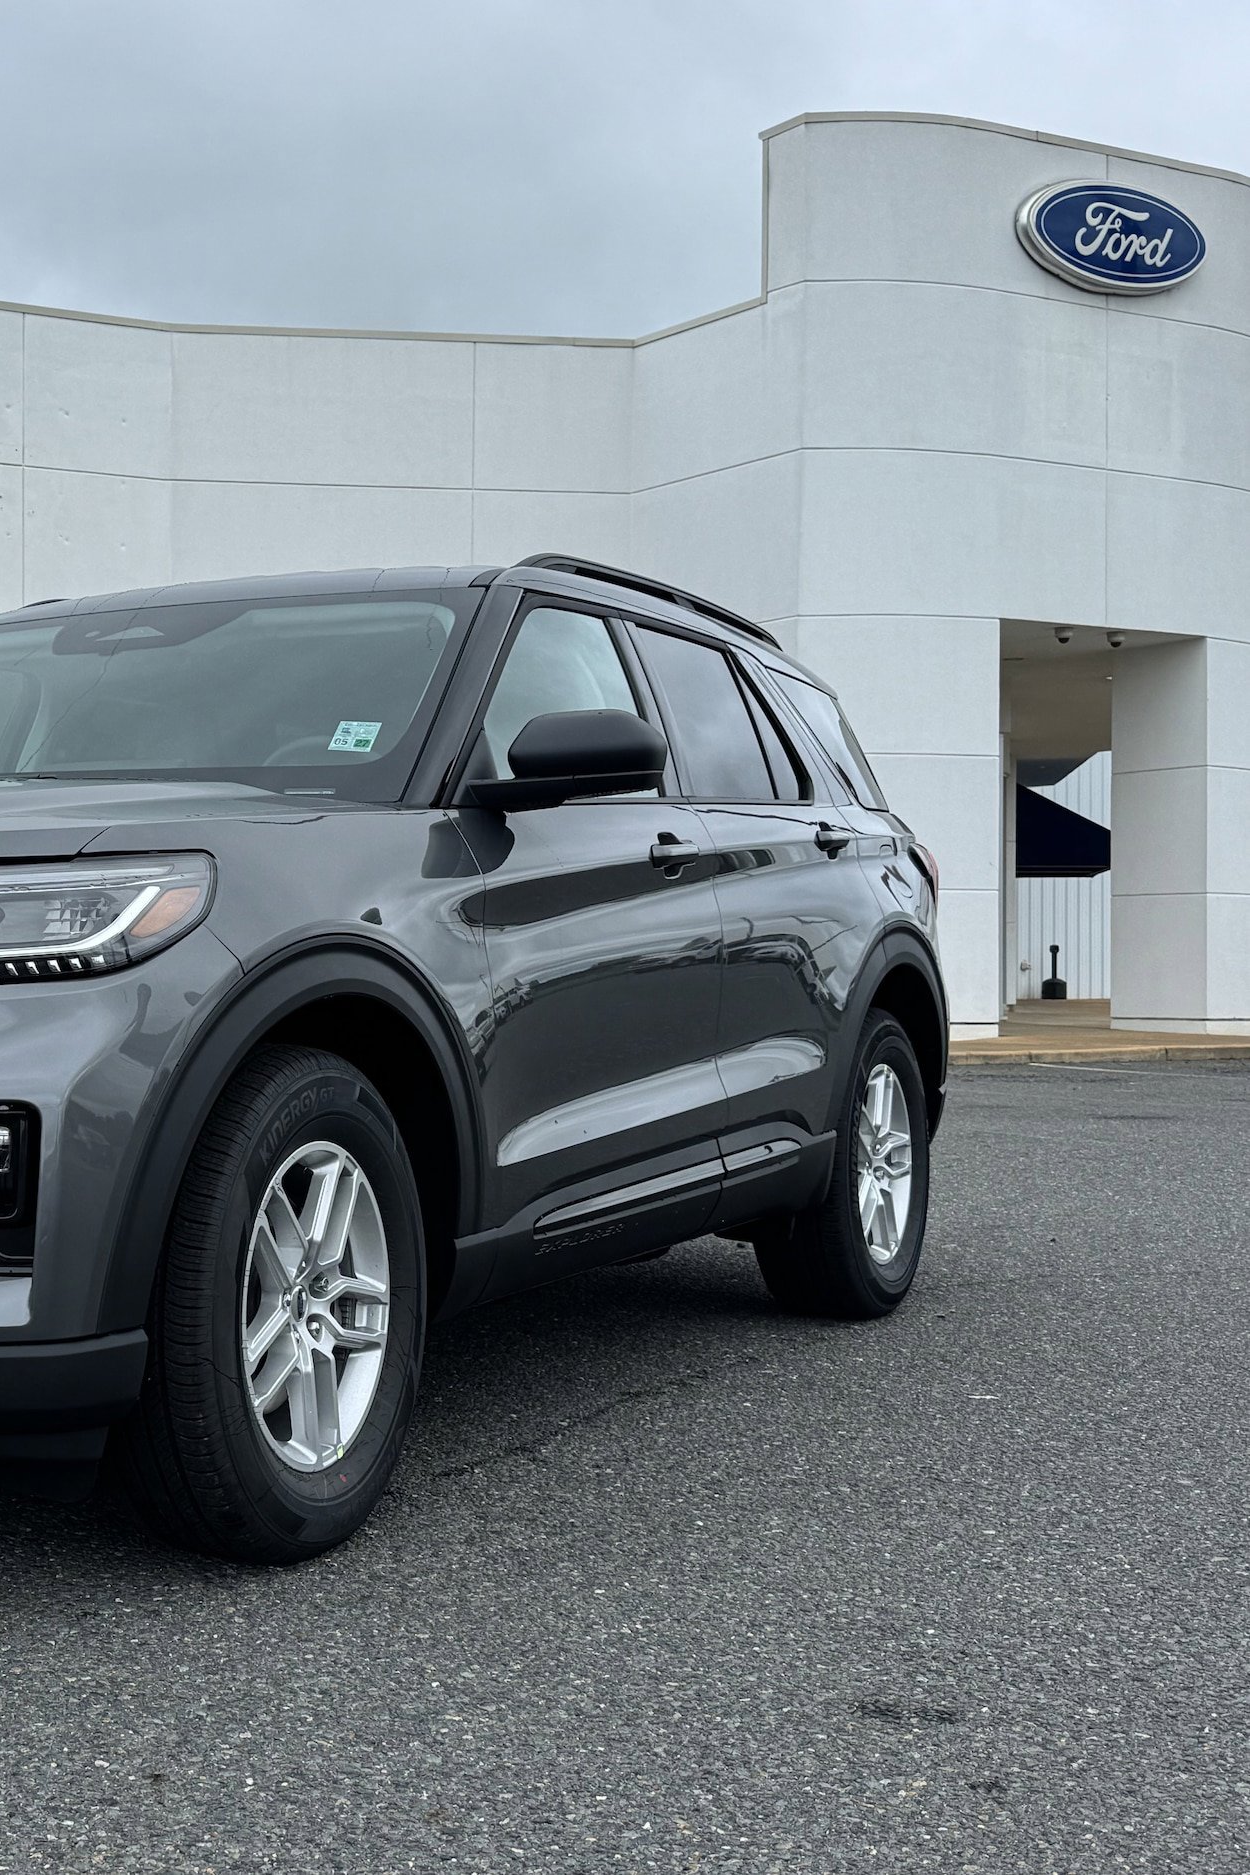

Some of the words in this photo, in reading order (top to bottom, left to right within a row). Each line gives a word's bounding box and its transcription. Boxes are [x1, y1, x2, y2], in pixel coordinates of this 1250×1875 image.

[1074, 201, 1174, 268] Ford
[334, 738, 348, 746] 05
[259, 1086, 319, 1167] KINERGY
[320, 1087, 334, 1101] GT
